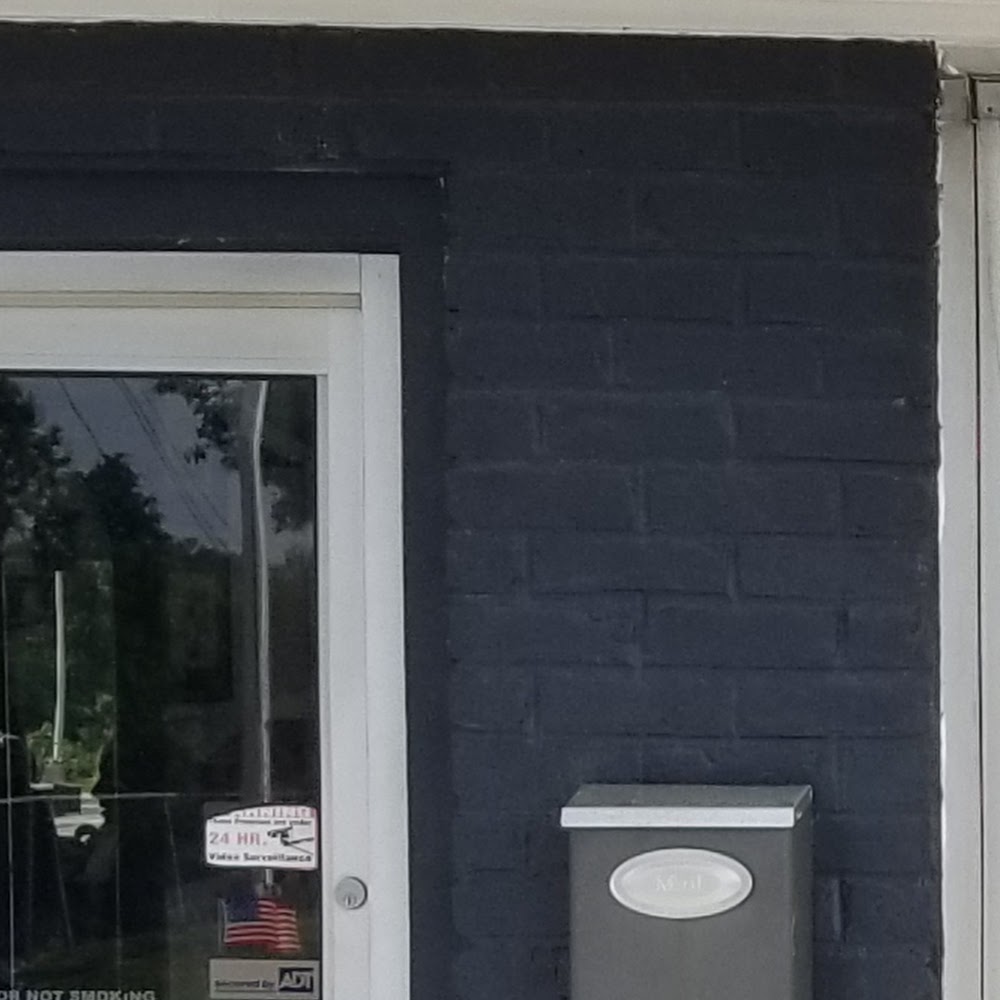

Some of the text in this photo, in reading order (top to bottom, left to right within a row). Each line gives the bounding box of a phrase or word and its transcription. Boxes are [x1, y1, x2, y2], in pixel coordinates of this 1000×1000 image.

[209, 831, 268, 846] 24 HR.
[209, 852, 240, 861] Video
[279, 971, 313, 990] ADT
